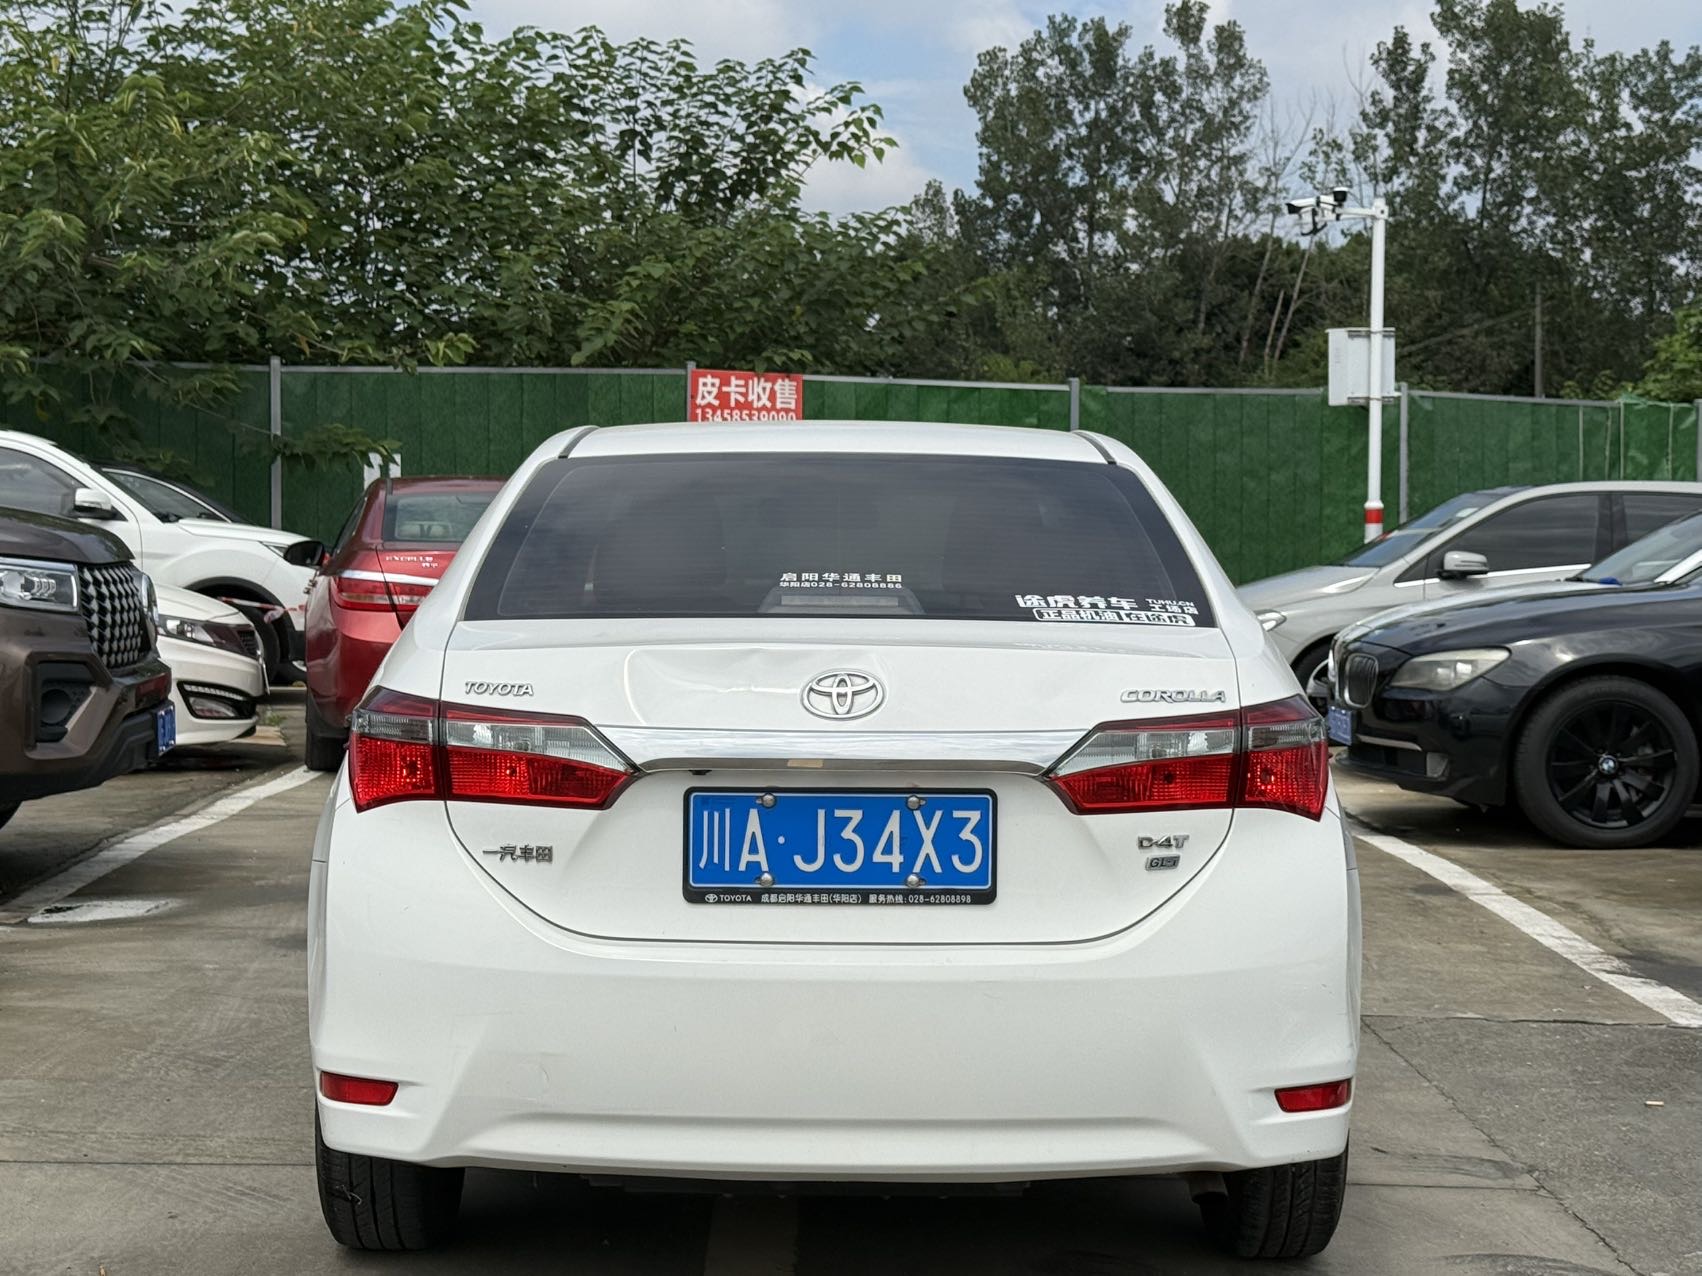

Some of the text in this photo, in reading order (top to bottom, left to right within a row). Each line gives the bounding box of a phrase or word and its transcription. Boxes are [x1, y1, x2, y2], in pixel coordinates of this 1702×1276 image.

[695, 374, 797, 410] 皮卡收售
[780, 572, 902, 583] 启阳华通丰田
[1014, 594, 1137, 610] 途虎养车
[1040, 610, 1118, 622] 正品机油
[465, 681, 534, 697] TOYOTA
[1120, 689, 1226, 703] COROLLA
[698, 807, 984, 874] 川A·J34X3
[1138, 834, 1190, 850] D-4T
[482, 843, 553, 863] 一汽丰田
[719, 893, 752, 903] TOYOTA
